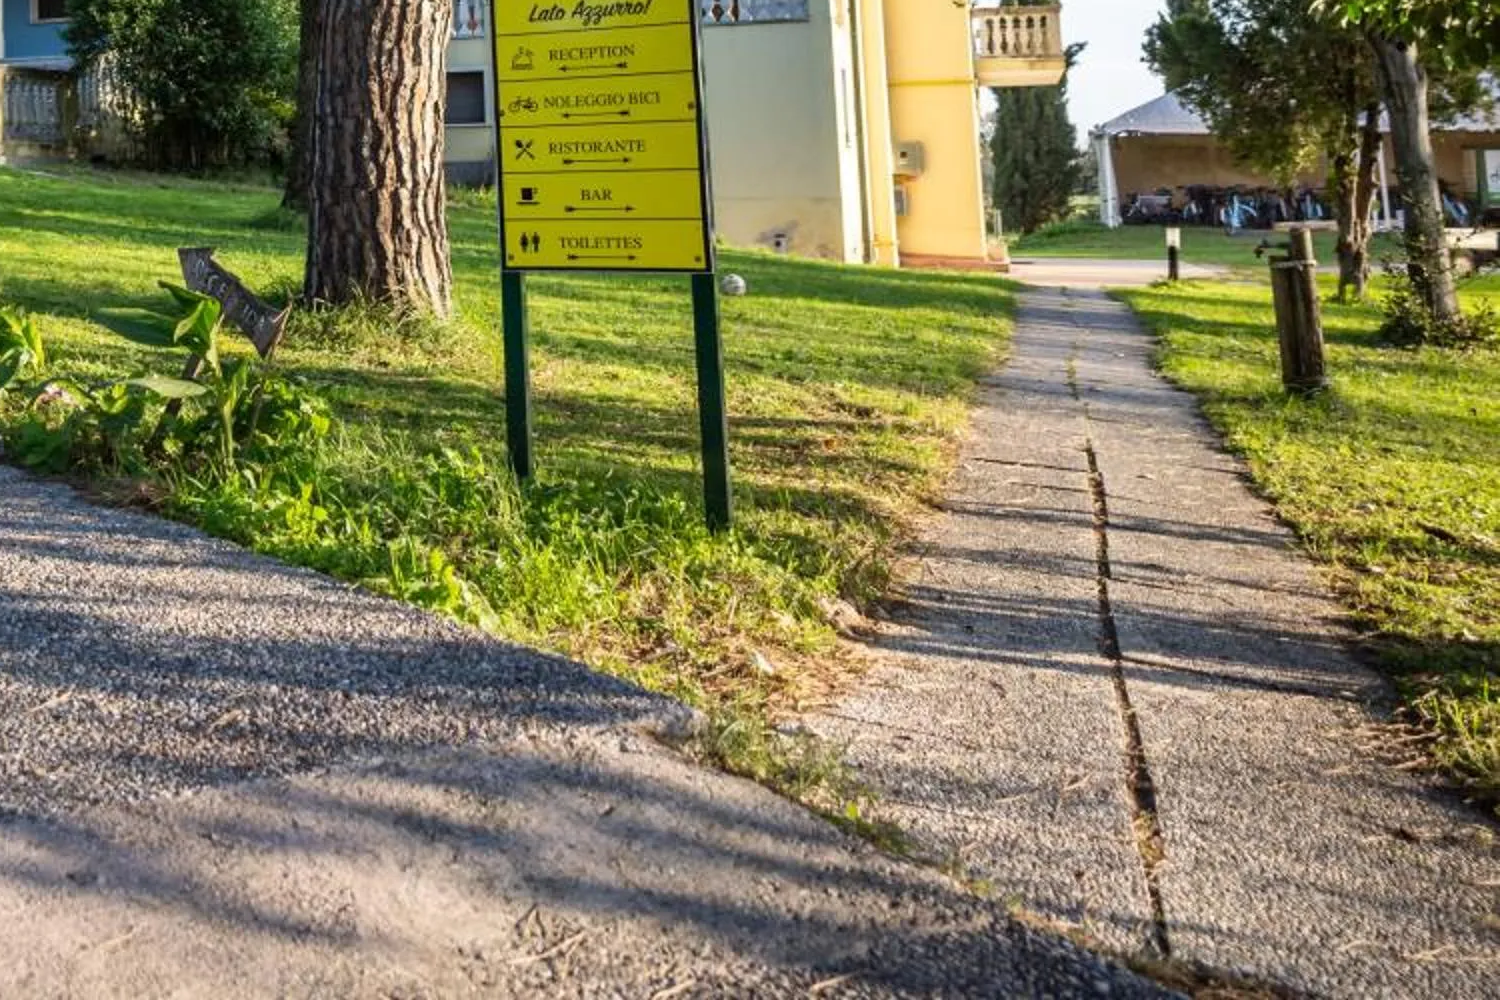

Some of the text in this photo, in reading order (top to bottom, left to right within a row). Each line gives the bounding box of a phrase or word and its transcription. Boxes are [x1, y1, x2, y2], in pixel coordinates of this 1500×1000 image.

[528, 3, 566, 23] Lato
[548, 44, 636, 61] RECEPTION
[543, 91, 661, 109] NOLEGGIO BICI
[548, 139, 646, 154] RISTORANTE
[580, 188, 613, 201] BAR
[558, 236, 643, 250] TOILETTES
